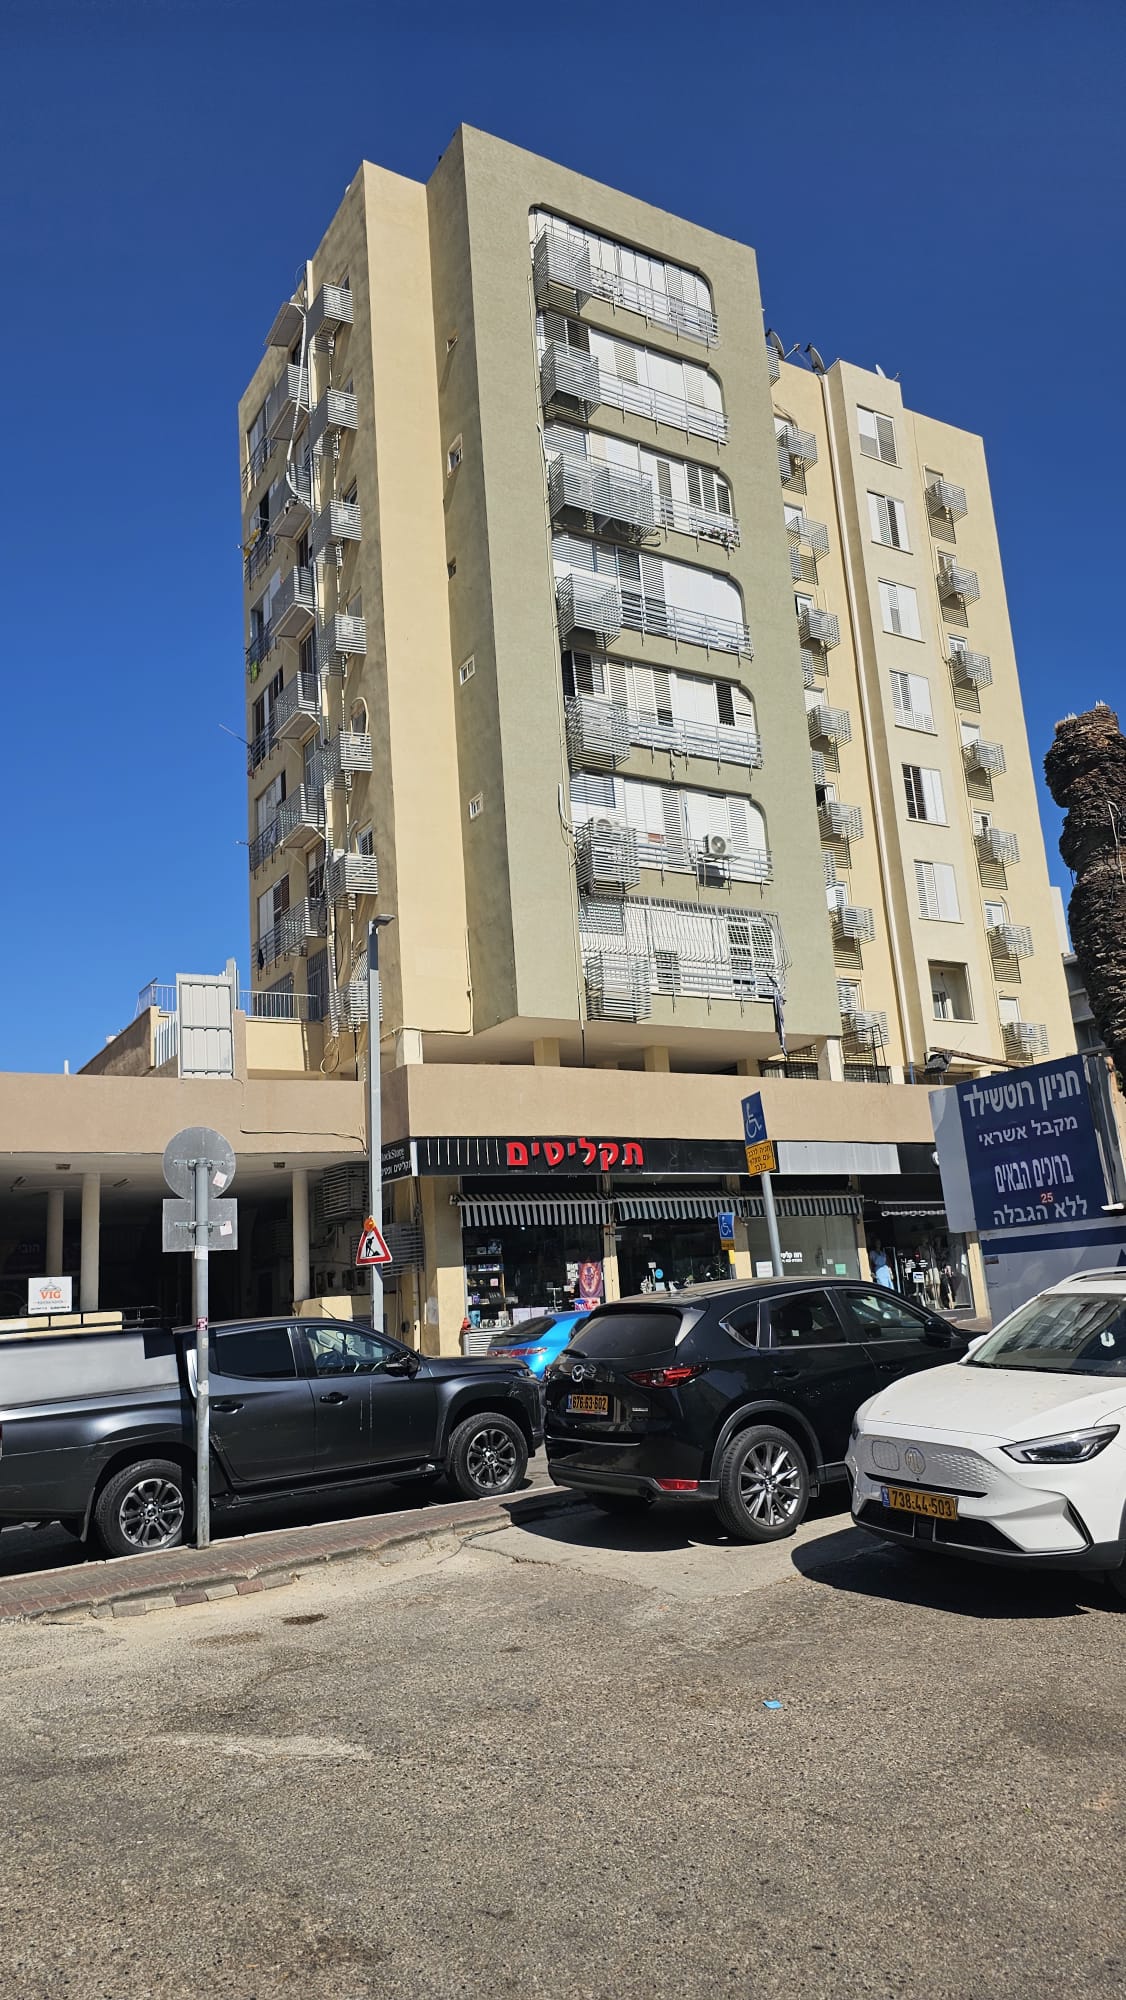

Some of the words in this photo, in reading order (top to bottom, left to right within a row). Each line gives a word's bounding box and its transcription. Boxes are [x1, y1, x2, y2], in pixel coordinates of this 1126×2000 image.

[963, 1080, 1035, 1117] רוטשילד
[1038, 1070, 1081, 1111] חניון
[978, 1126, 1028, 1147] אשראי
[1031, 1116, 1078, 1137] מקבל
[506, 1137, 644, 1171] תקליטים
[994, 1161, 1032, 1193] הבאים
[1032, 1153, 1075, 1187] ברוכים
[1040, 1193, 1054, 1204] 25
[1054, 1195, 1088, 1219] ללא
[993, 1203, 1049, 1225] הגבלה
